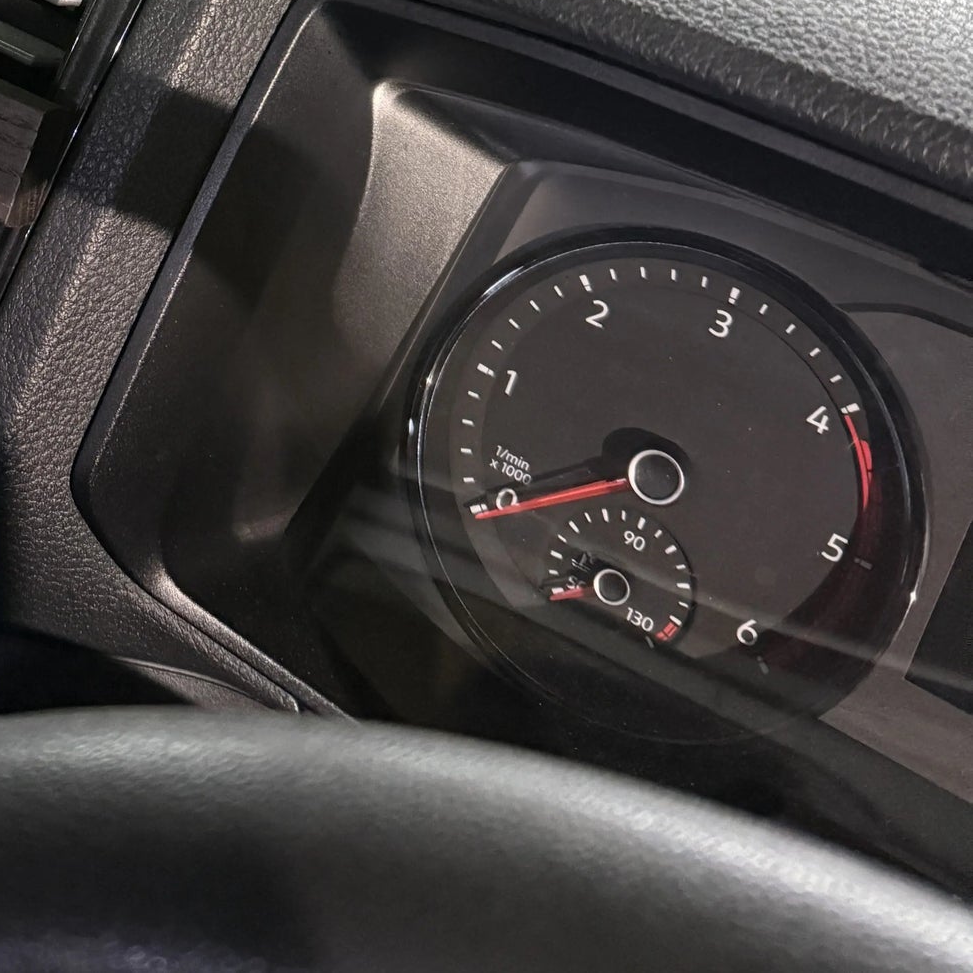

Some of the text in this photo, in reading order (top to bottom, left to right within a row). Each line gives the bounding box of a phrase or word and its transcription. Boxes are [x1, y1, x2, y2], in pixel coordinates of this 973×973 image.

[585, 299, 610, 329] 2
[708, 309, 733, 338] 3
[504, 370, 518, 397] 1
[806, 406, 830, 434] 4
[495, 445, 531, 471] 1/min
[501, 461, 533, 486] 1000
[624, 530, 646, 552] 90
[821, 533, 849, 563] 5
[627, 607, 654, 632] 130
[736, 619, 759, 647] 6
